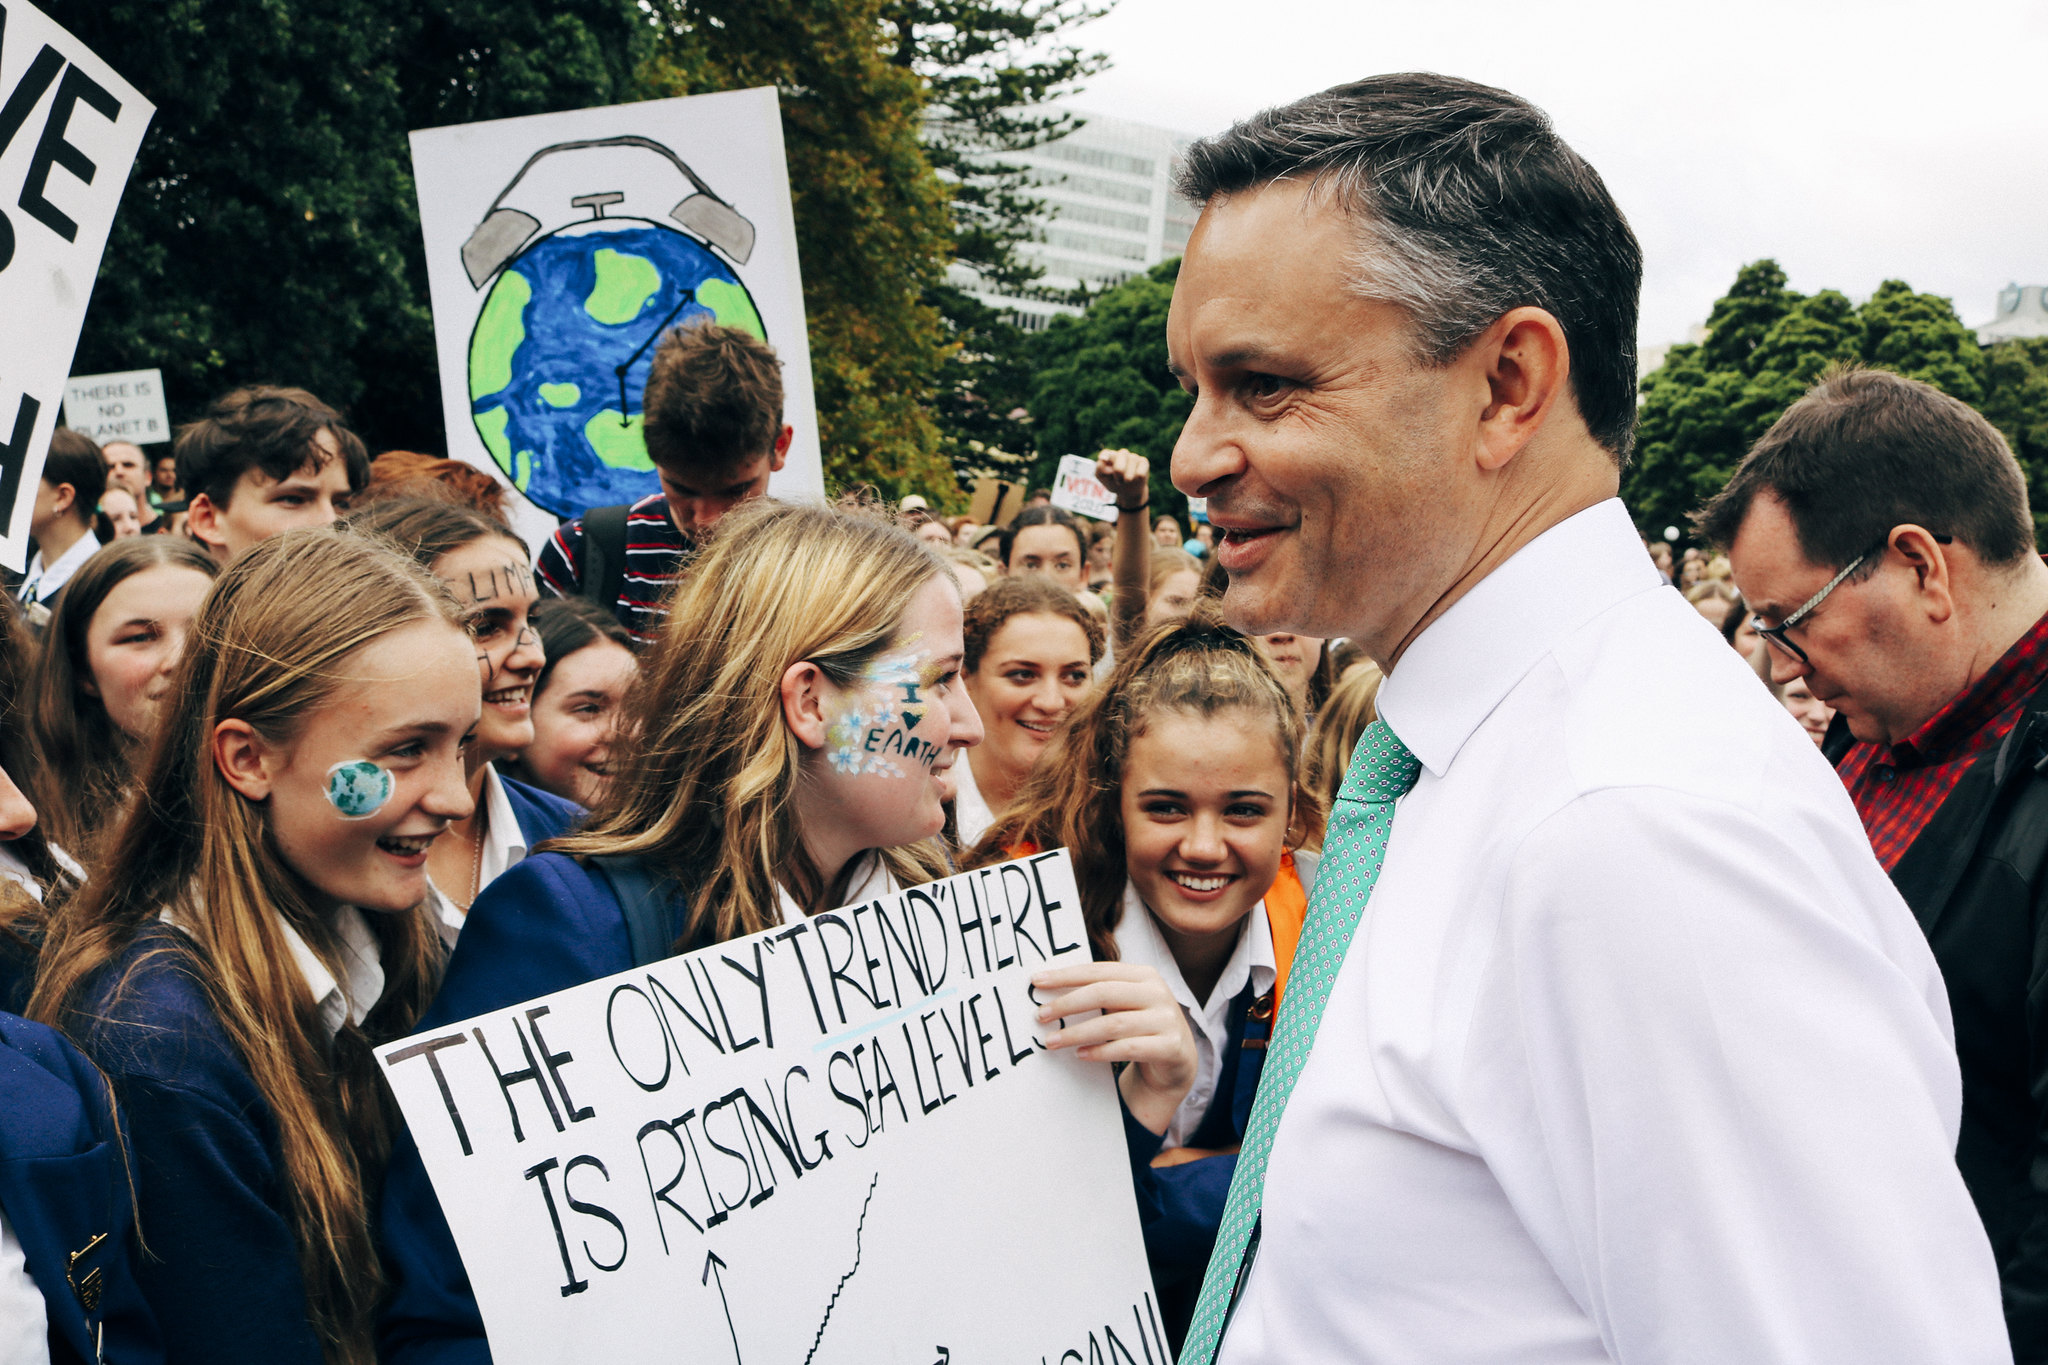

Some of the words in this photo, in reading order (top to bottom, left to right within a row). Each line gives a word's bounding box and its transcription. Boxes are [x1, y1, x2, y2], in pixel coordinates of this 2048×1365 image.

[72, 383, 129, 401] THERE
[135, 381, 151, 396] IS
[98, 403, 125, 417] NO
[147, 418, 159, 432] B
[896, 682, 923, 704] I
[864, 728, 942, 767] EARTH
[385, 1005, 596, 1157] THE
[606, 942, 775, 1093] ONLY
[950, 851, 1081, 980] HERE
[523, 1154, 628, 1298] IS
[636, 1065, 834, 1256] RISING
[827, 1035, 909, 1149] SEA
